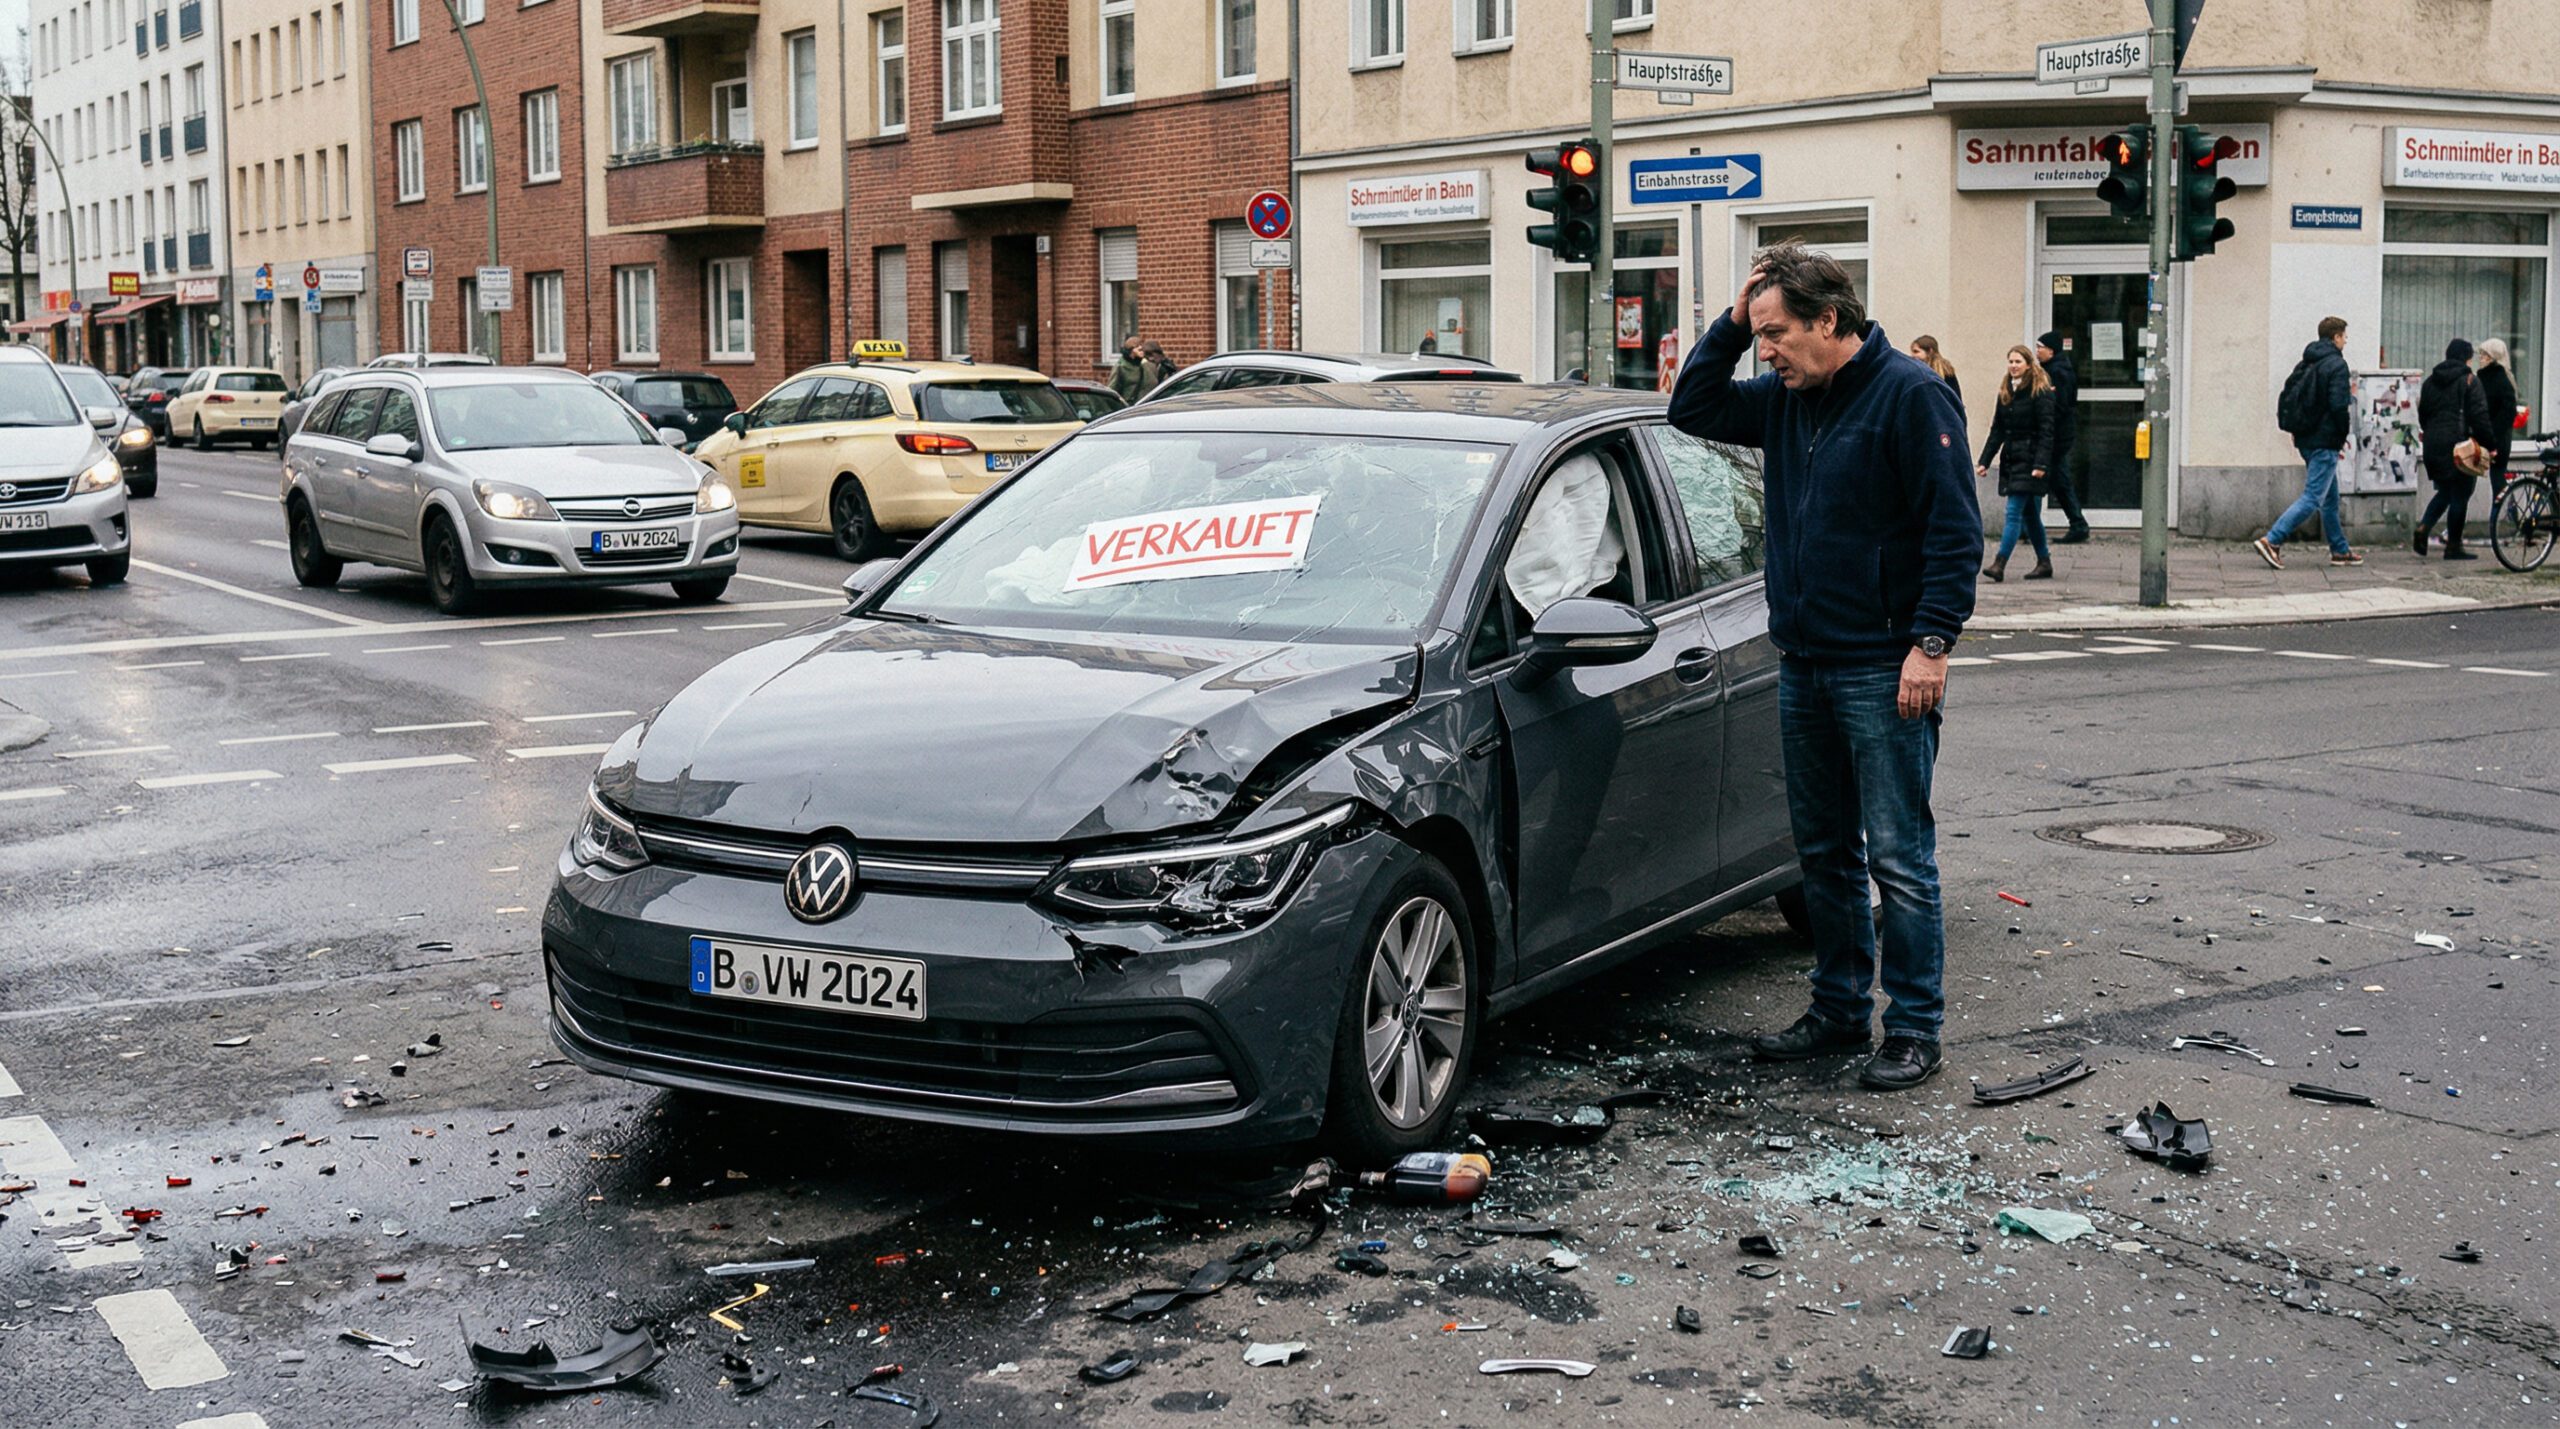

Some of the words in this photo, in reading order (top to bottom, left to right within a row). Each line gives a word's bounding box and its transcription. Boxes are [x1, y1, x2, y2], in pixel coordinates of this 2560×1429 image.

[2518, 143, 2533, 165] in
[1425, 182, 1437, 201] in
[1440, 180, 1474, 200] Bahn
[1638, 173, 1730, 188] Einbahnstrasse
[602, 534, 612, 549] B
[622, 532, 640, 547] VW
[643, 530, 676, 547] 2024
[1088, 509, 1313, 566] VERKAUFT
[713, 948, 736, 989] B
[762, 954, 810, 999] VW
[821, 960, 919, 1012] 2024
